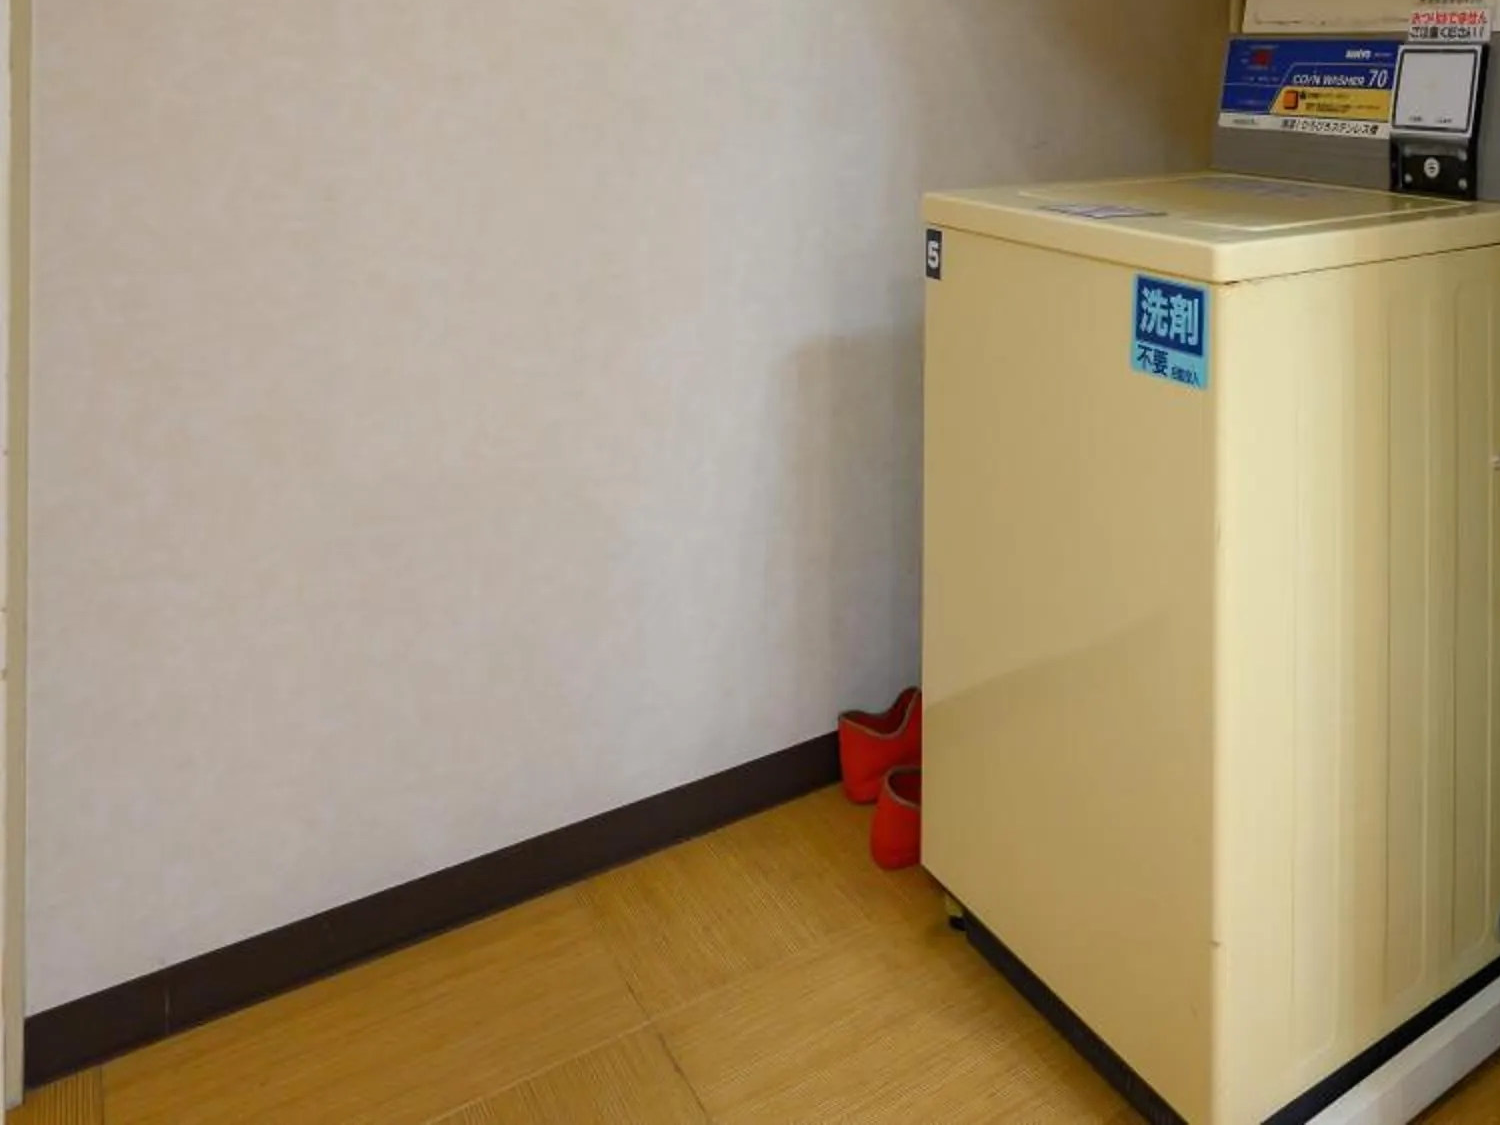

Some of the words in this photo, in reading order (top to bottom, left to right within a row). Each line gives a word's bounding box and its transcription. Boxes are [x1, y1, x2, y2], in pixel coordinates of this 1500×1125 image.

[1323, 74, 1366, 87] WASHER
[1367, 68, 1389, 88] 70
[927, 240, 939, 269] 5
[1140, 286, 1200, 346] 洗剤
[1136, 344, 1169, 377] 不要
